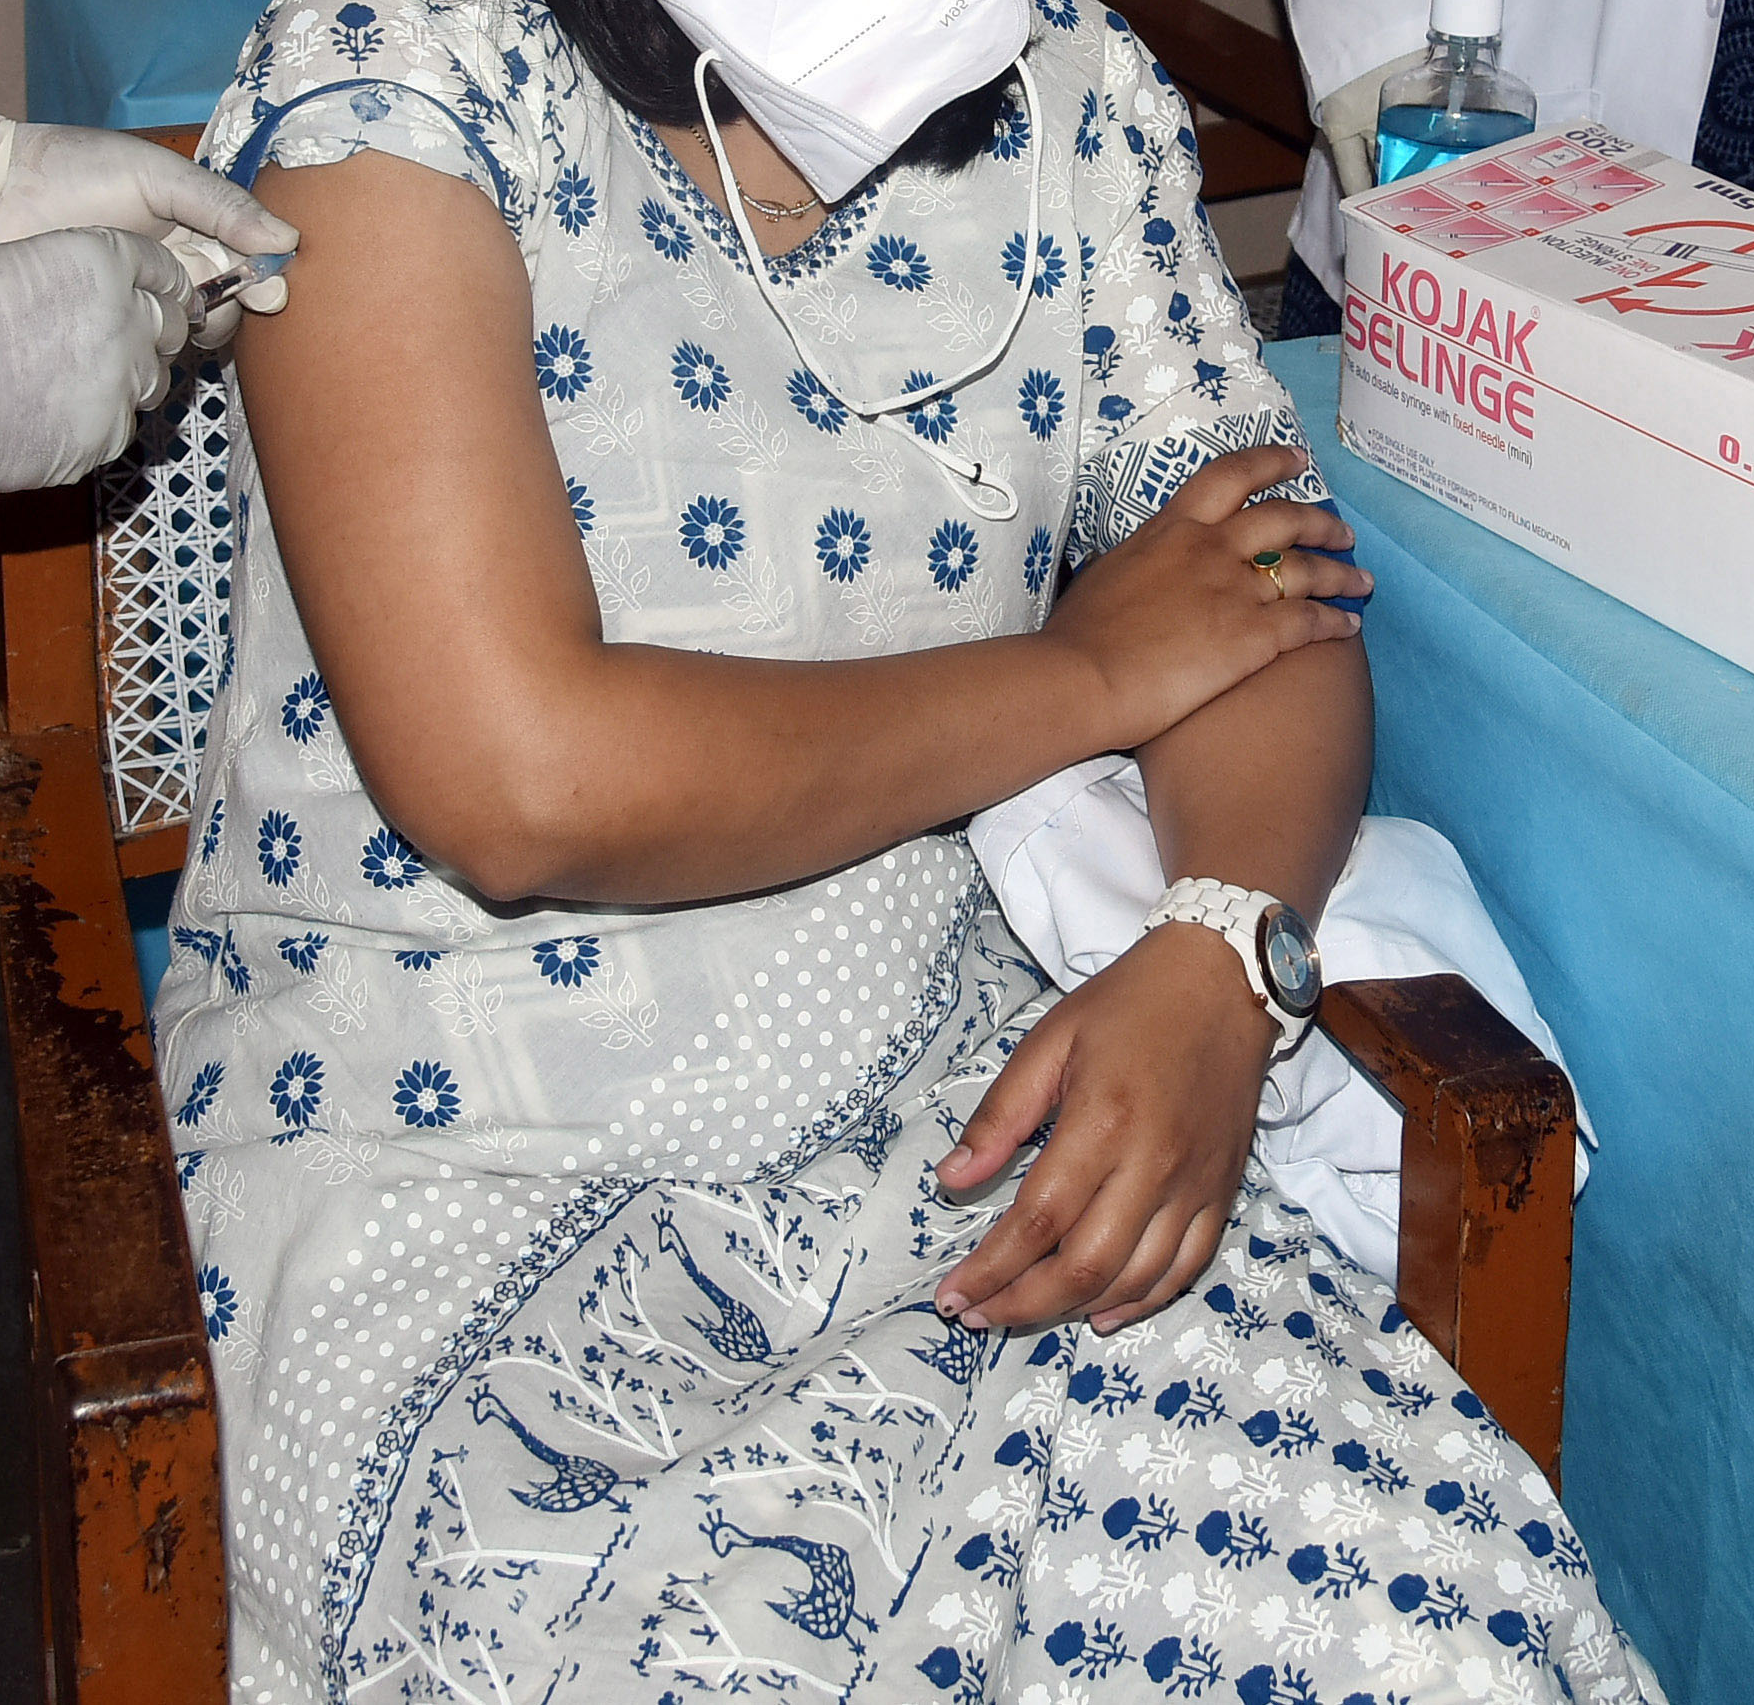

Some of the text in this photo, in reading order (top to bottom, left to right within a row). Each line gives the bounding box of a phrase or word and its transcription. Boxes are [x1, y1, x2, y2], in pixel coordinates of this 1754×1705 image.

[1565, 130, 1627, 157] 200
[1584, 127, 1635, 150] UNITS
[1536, 234, 1642, 279] ONE INJECTION
[1574, 235, 1661, 273] ONE SYRINGE
[1380, 251, 1539, 376] KOJAK
[1344, 290, 1535, 440] SELINGE
[1355, 365, 1371, 383] auto
[1371, 373, 1399, 400] disable
[1400, 391, 1431, 417] syringe
[1433, 407, 1451, 425] with
[1452, 412, 1474, 437] fixed
[1475, 428, 1505, 453] needle
[1507, 440, 1533, 471] (mini)
[1370, 452, 1395, 472] COMPLIES
[1396, 466, 1409, 479] WITH
[1372, 428, 1434, 469] FOR SINGLE USE ONLY
[1388, 448, 1405, 465] PUSH
[1406, 457, 1417, 472] THE
[1418, 463, 1446, 486] PLUNGER
[1447, 479, 1477, 503] FORWARD
[1478, 494, 1497, 513] PRIOR
[1498, 505, 1507, 519] TO
[1507, 510, 1531, 531] FILLING
[1531, 522, 1571, 552] MEDICATION
